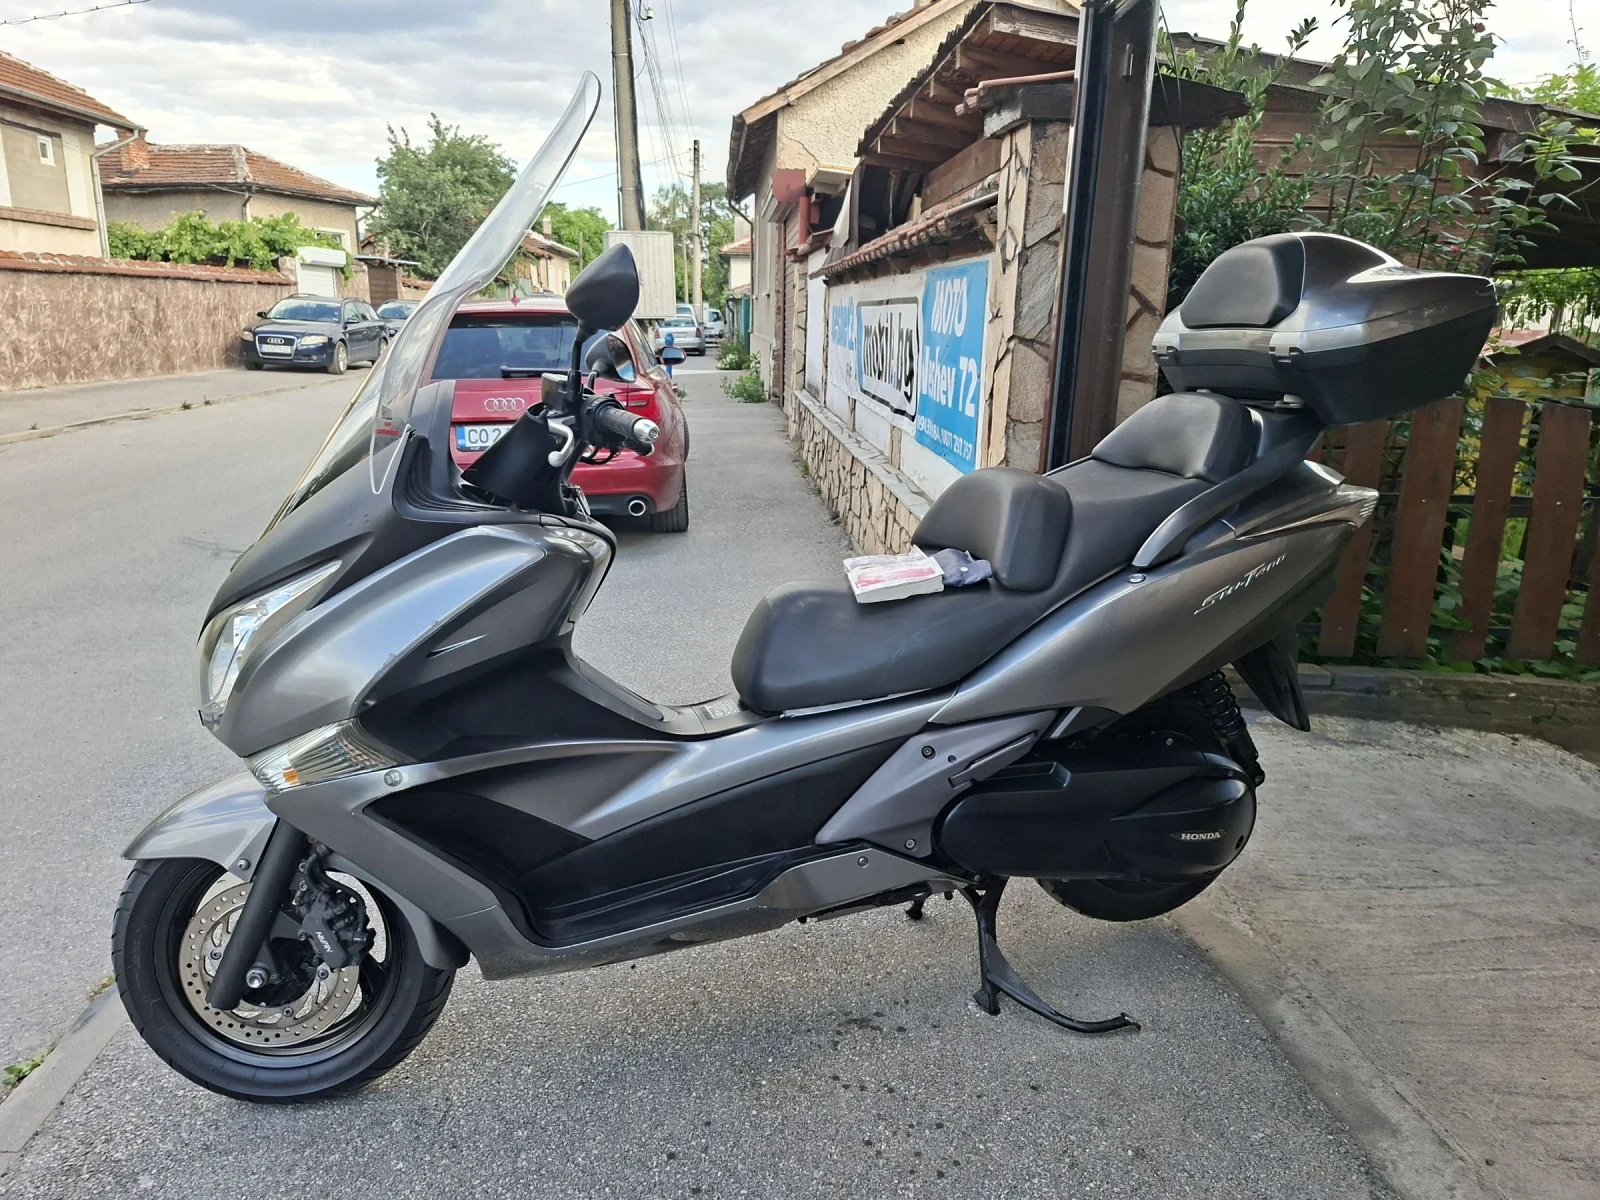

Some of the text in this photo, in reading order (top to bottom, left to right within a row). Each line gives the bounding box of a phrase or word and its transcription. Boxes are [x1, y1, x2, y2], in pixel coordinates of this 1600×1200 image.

[931, 277, 967, 337] MOTO
[863, 312, 914, 404] mobil.bg
[959, 355, 977, 417] 72
[1181, 832, 1221, 840] HONDA
